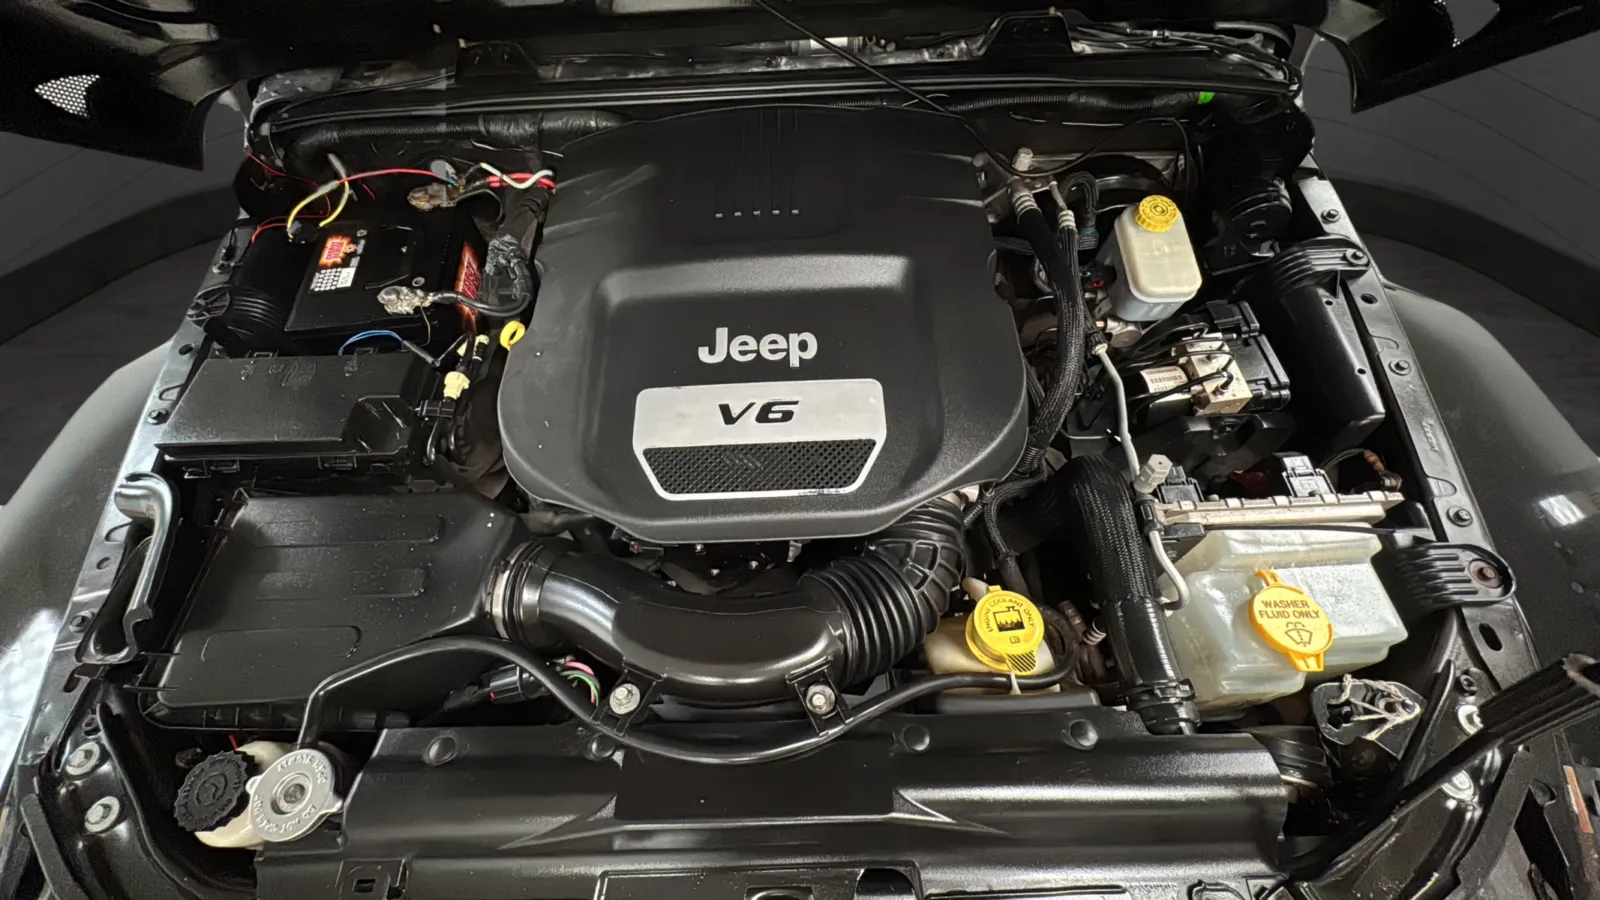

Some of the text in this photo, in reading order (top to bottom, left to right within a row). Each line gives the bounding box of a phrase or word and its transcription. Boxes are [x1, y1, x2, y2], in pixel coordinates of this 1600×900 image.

[698, 327, 818, 367] Jeep
[718, 400, 800, 425] V6
[984, 598, 1036, 633] ENGINE COOLANT ONLY
[1258, 610, 1320, 619] FLUID ONLY
[1261, 600, 1310, 609] WASHER
